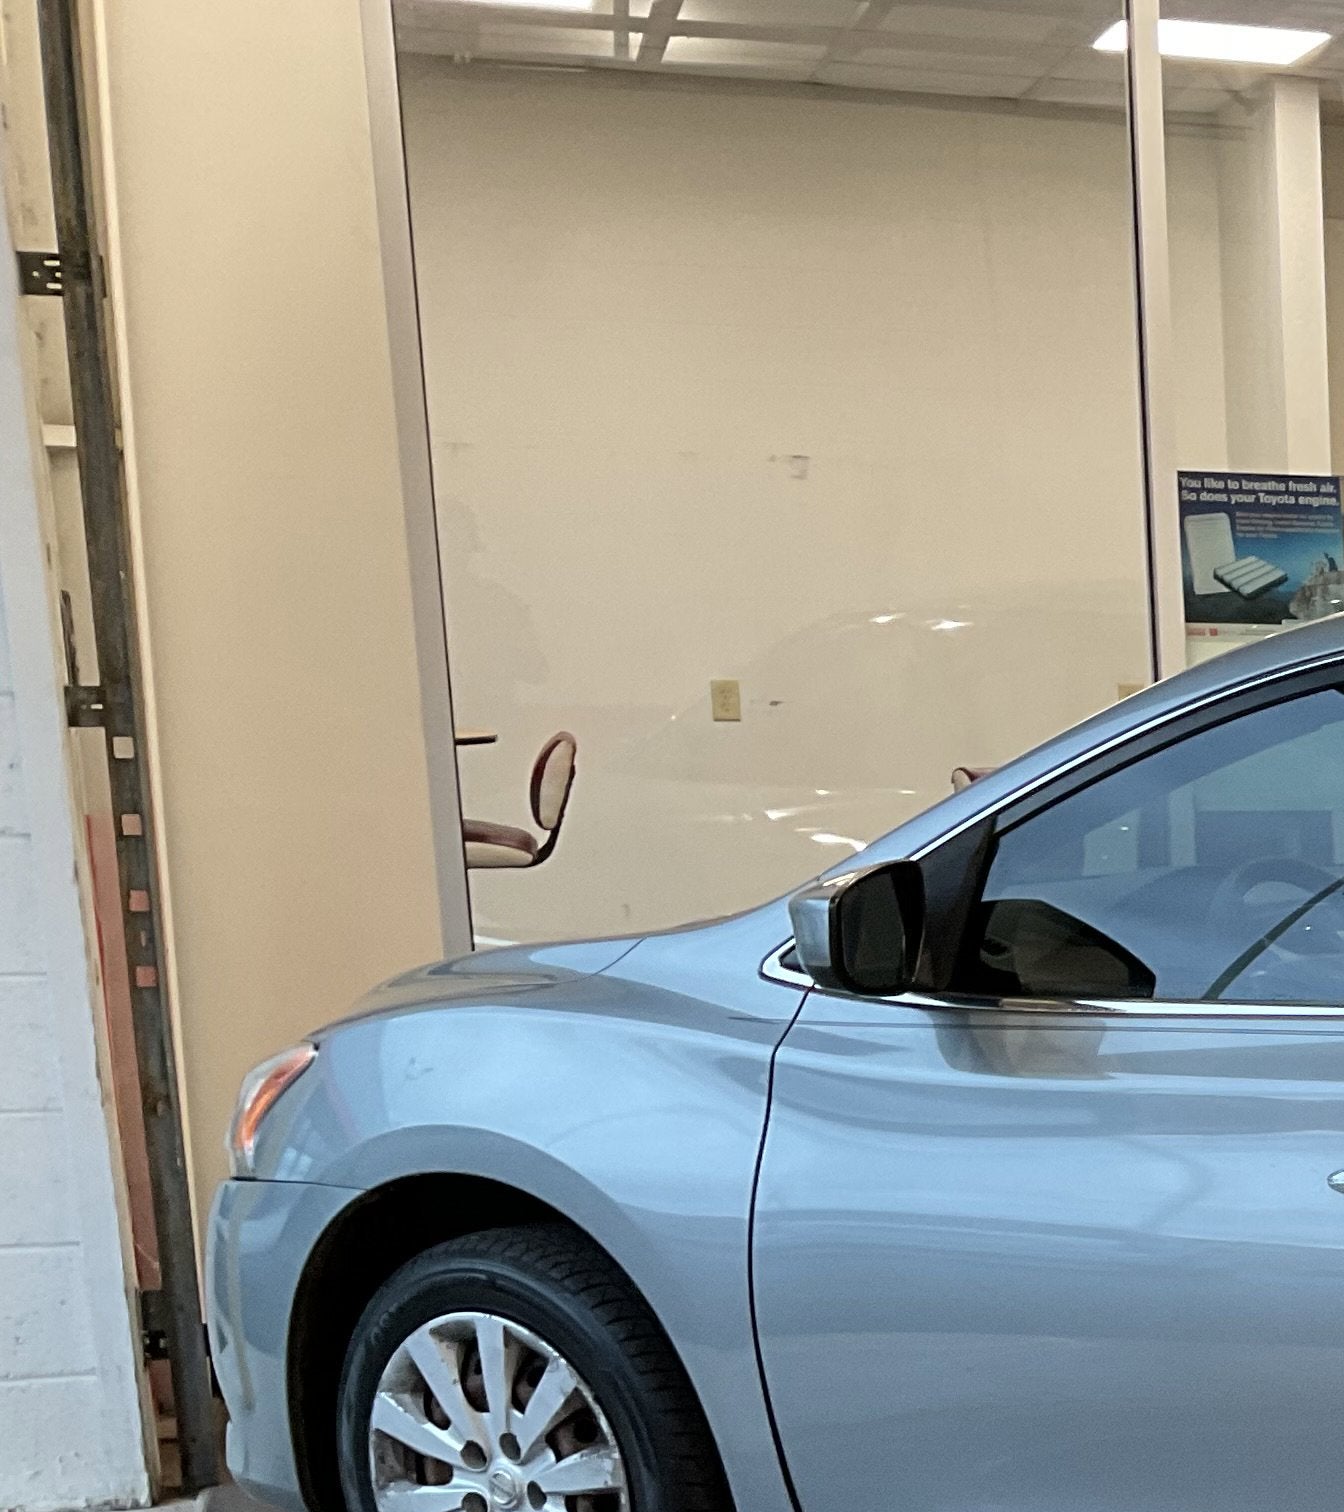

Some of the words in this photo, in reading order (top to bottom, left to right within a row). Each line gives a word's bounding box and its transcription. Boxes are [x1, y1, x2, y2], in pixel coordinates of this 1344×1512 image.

[1179, 476, 1201, 489] You
[1203, 477, 1225, 489] like
[1227, 478, 1240, 490] to
[1241, 479, 1286, 492] breathe
[1288, 480, 1317, 493] fresh
[1319, 482, 1337, 494] air.
[1181, 490, 1197, 501] So
[1199, 491, 1228, 502] does
[1230, 493, 1256, 505] your
[1258, 492, 1296, 506] Toyota
[1297, 495, 1340, 507] engine.
